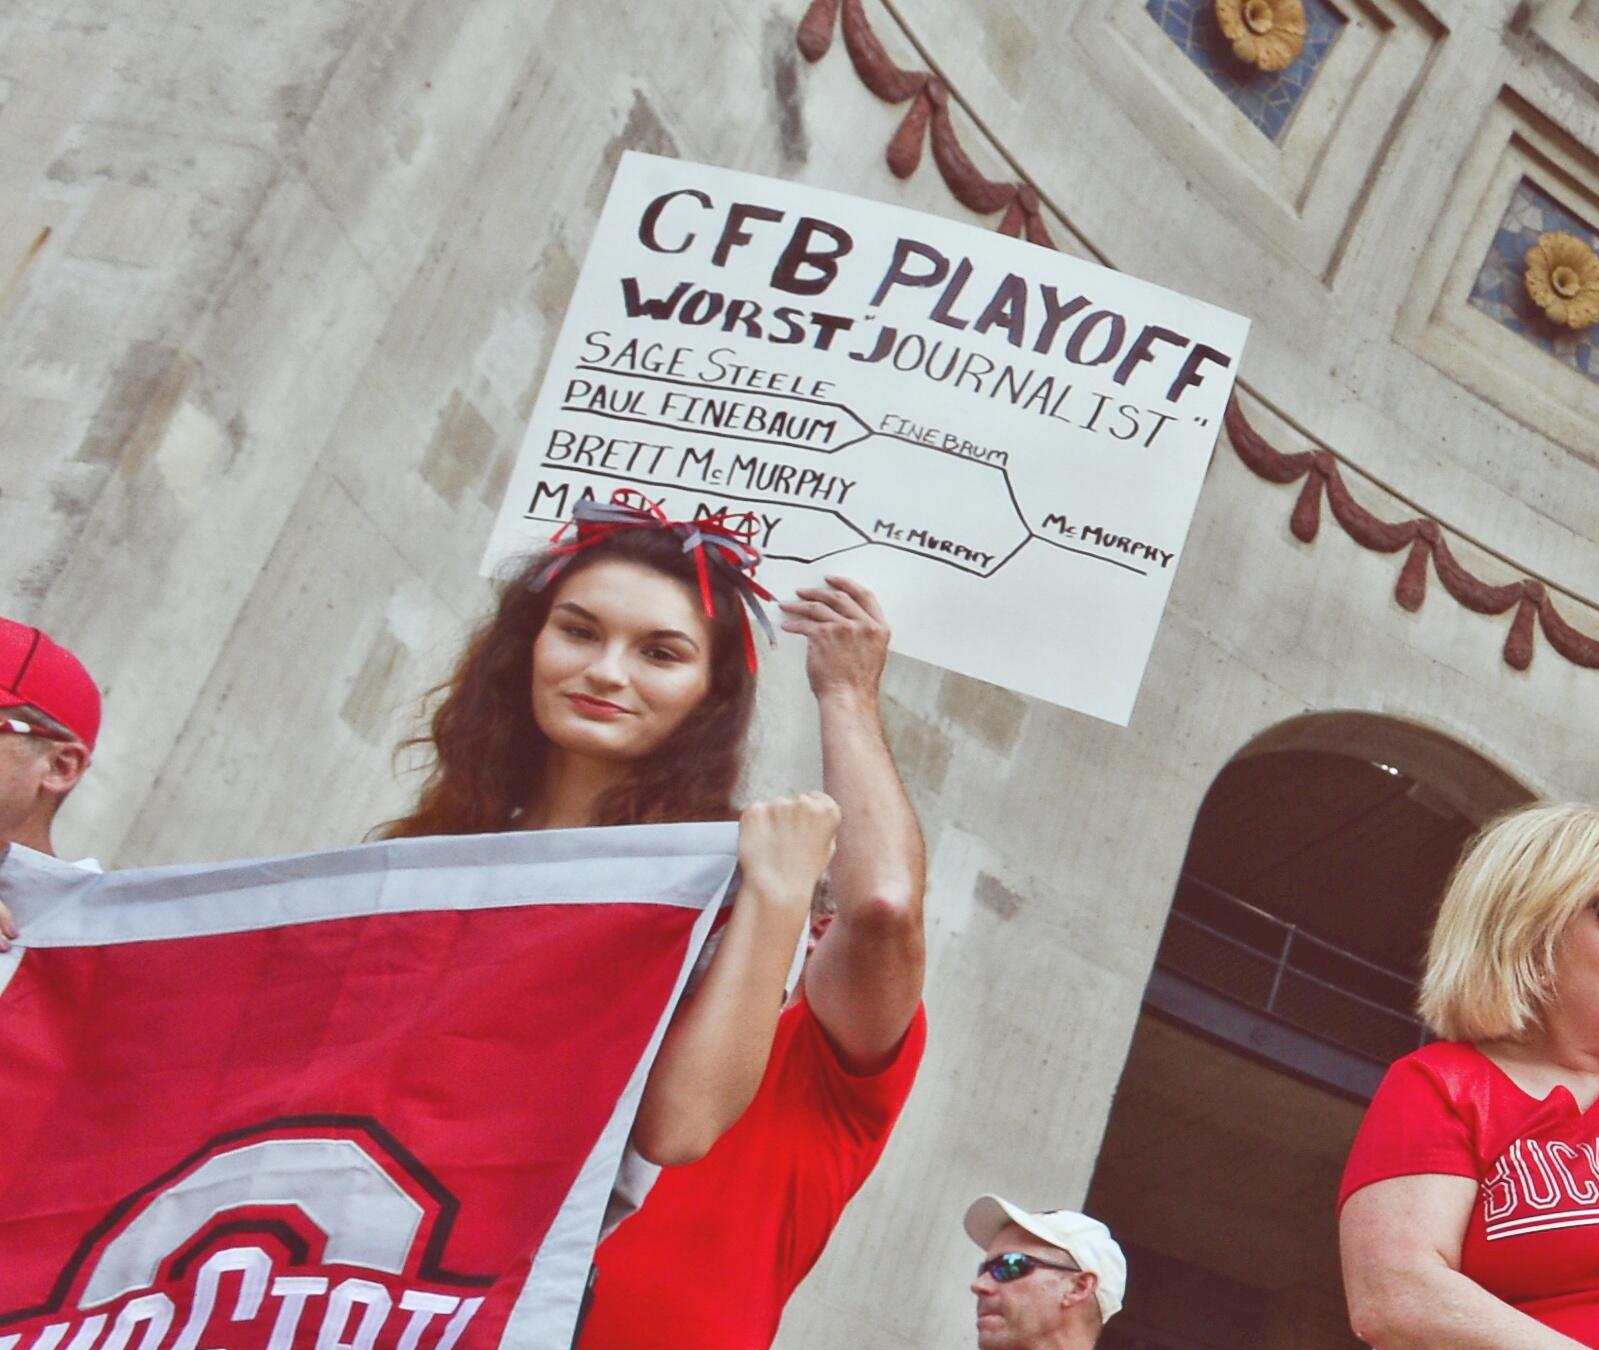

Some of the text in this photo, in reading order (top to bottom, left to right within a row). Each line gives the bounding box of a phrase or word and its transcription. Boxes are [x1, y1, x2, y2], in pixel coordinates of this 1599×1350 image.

[621, 277, 852, 351] WORST
[638, 189, 1231, 402] CFB PLAYOFF
[580, 330, 836, 398] SAGE STEELE
[564, 379, 838, 443] PAUL FINEBAUM
[545, 429, 675, 475] BRETT
